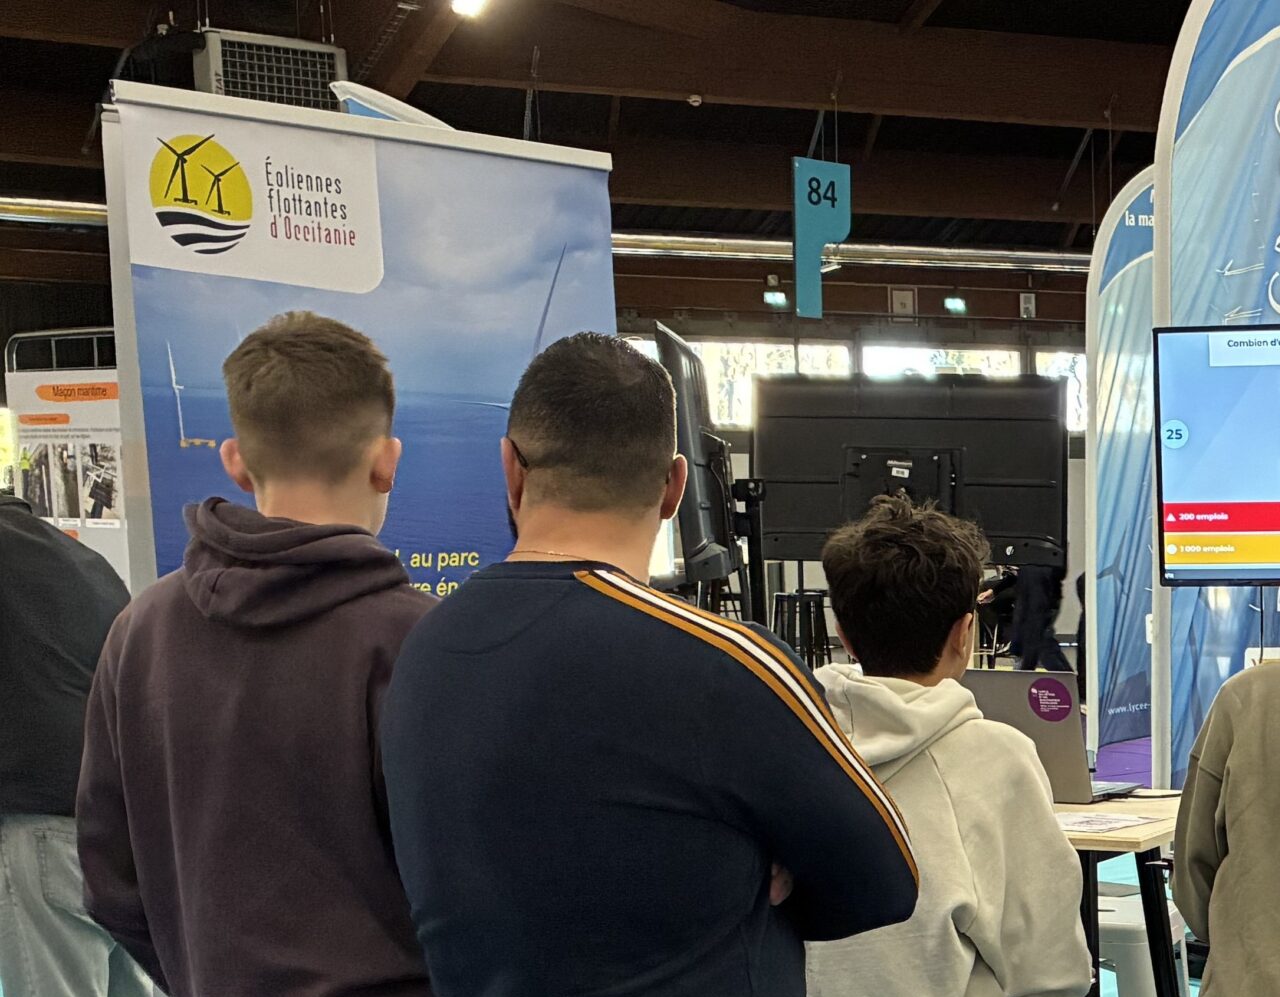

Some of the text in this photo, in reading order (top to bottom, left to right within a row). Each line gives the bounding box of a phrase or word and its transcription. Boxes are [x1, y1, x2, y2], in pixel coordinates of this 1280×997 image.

[264, 155, 342, 195] Éoliennes
[807, 176, 838, 209] 84
[267, 187, 348, 220] flottantes
[1125, 210, 1136, 226] la
[270, 214, 356, 247] d'Occitanie
[1227, 338, 1269, 348] Combien
[1166, 428, 1183, 440] 25
[1196, 512, 1229, 522] emplois
[1203, 544, 1235, 553] emplois
[409, 553, 433, 567] au
[437, 551, 480, 572] parc
